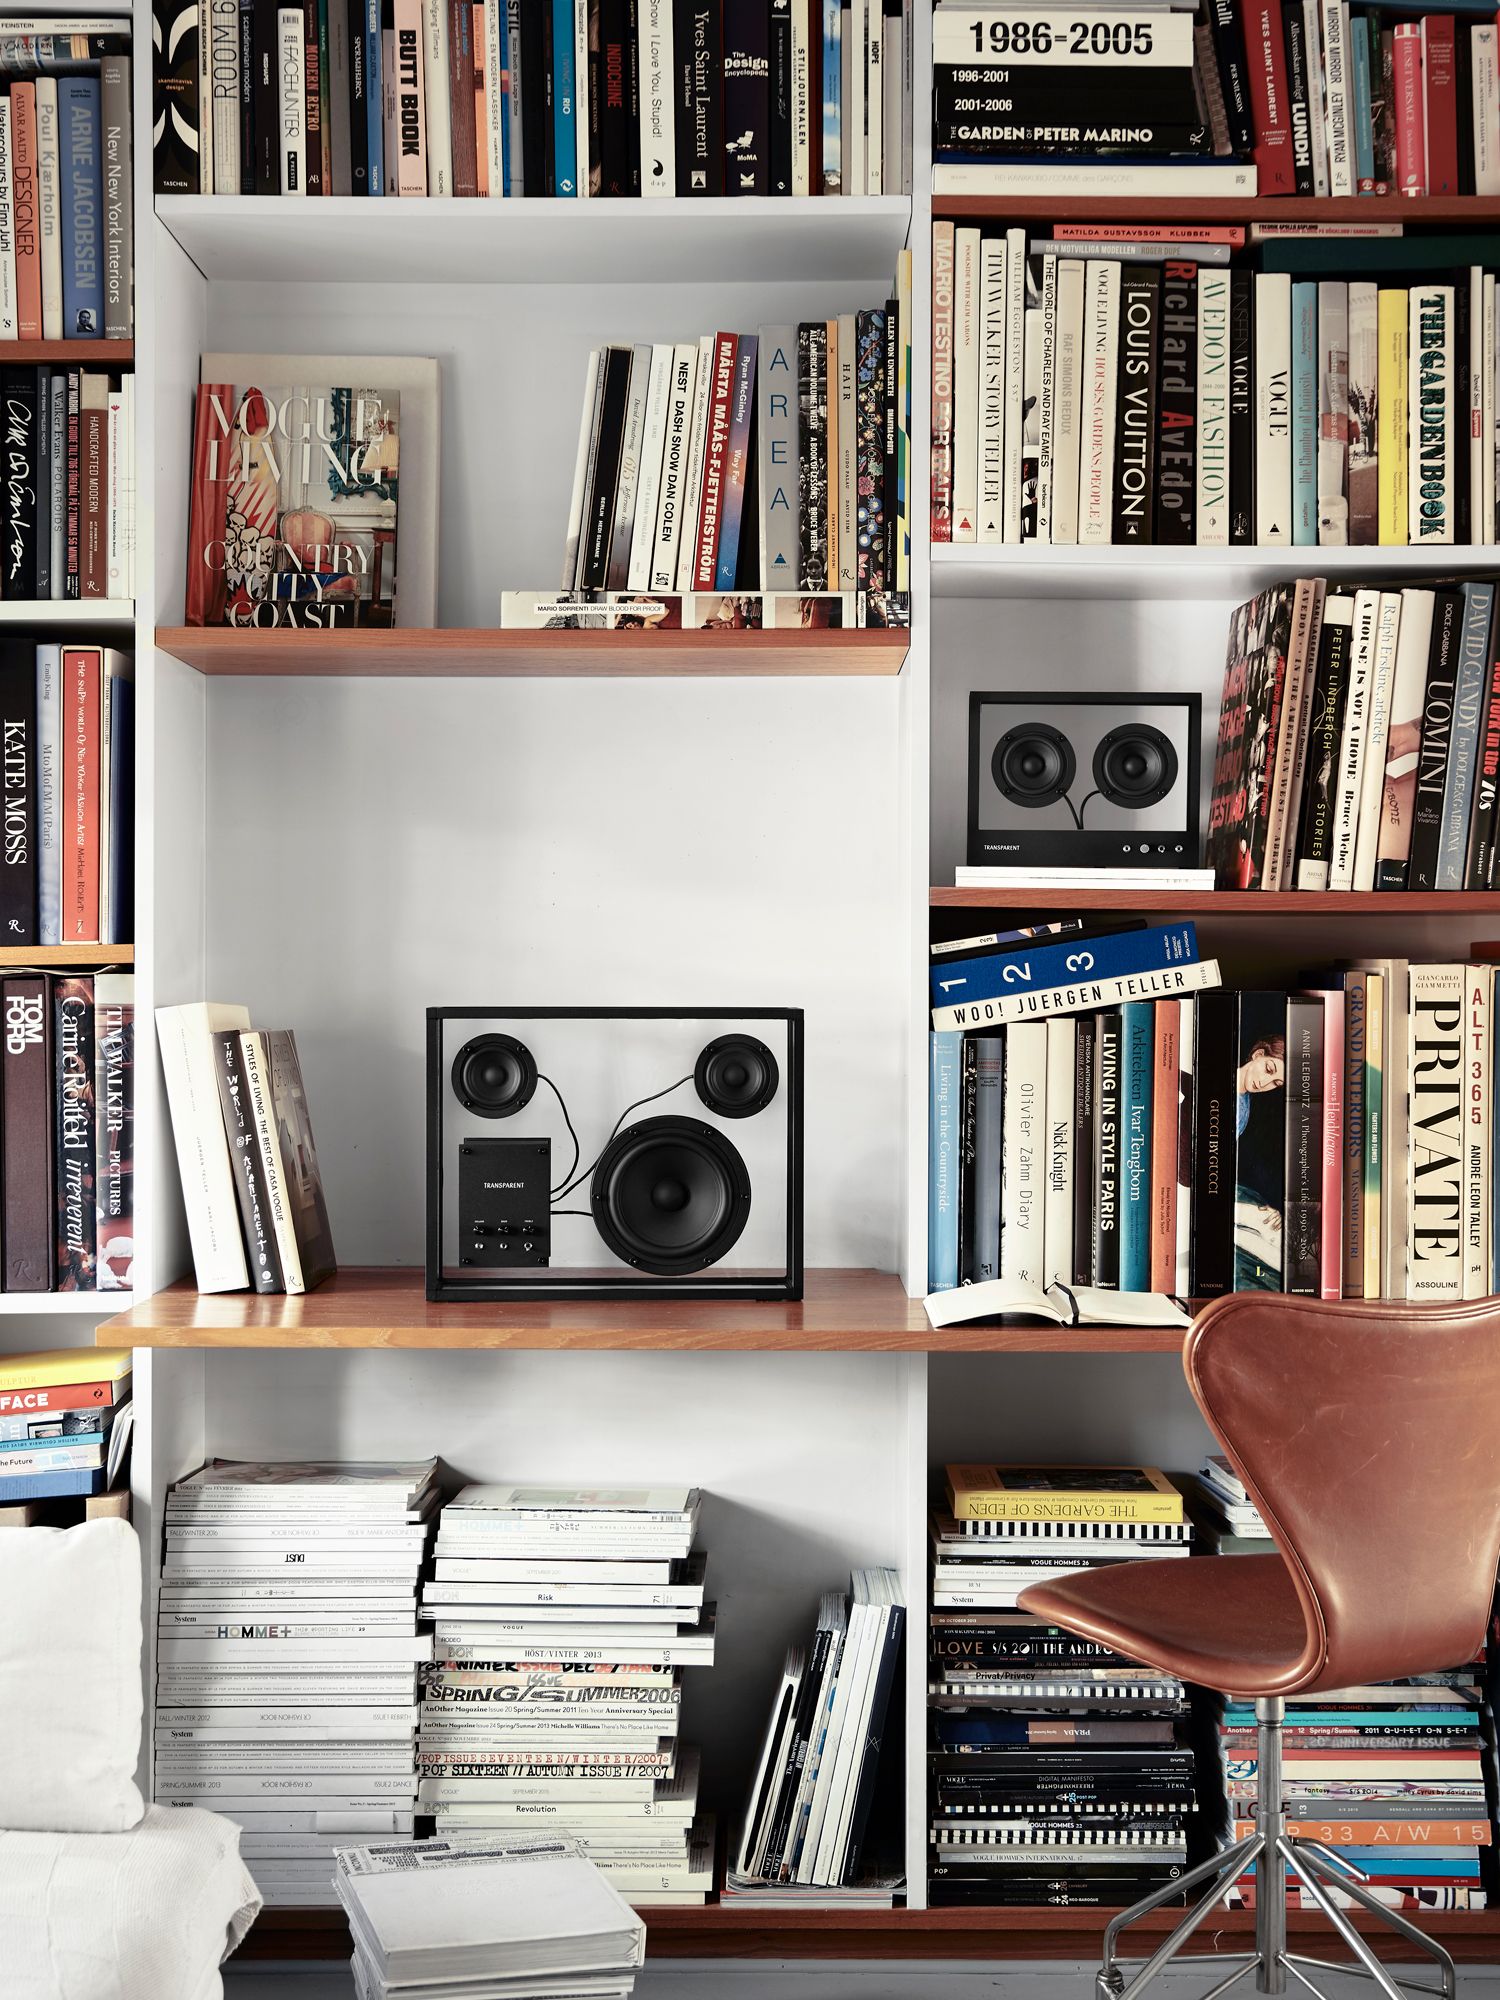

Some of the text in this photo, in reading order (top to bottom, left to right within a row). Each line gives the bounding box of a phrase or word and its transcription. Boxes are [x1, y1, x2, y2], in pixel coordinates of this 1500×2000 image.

[608, 44, 622, 108] INDOCHINE
[694, 10, 710, 158] Yves Saint Laurent
[724, 58, 768, 70] Design
[872, 40, 880, 64] HOPE
[952, 70, 1009, 82] 1996-2001
[284, 44, 299, 138] FACEHUNTER
[399, 30, 420, 156] BUTT BOOK
[798, 48, 806, 146] STILJOURNALEN
[954, 100, 1012, 111] 2001-2006
[70, 106, 94, 166] ARNE
[958, 126, 1153, 142] GARDEN PETER MARINO
[1292, 103, 1310, 167] LUNDH
[15, 92, 34, 256] ALVAR AALTO DESIGNER
[72, 169, 96, 289] JACOBSEN
[108, 126, 124, 304] New New York Interiors
[842, 364, 850, 400] HAIR
[1041, 261, 1054, 468] THE WORLD OF CHARLES AND RAY EAMES
[1203, 277, 1226, 508] AVEDON FASHION
[204, 394, 384, 442] VOGUE
[732, 356, 750, 486] Ryan McGinley Way Far
[1121, 292, 1151, 516] LOUIS VUITTON
[1269, 370, 1288, 437] VOGUE
[1420, 294, 1446, 536] THE GARDEN BOOK
[54, 390, 64, 532] Walker Evans POLAROIDS
[89, 416, 99, 512] HANDCRAFTED MODERN
[204, 440, 382, 486] LIVING
[662, 362, 688, 542] NEST DASH SNOW DAN COLEN
[699, 342, 734, 582] MÄRTA MÅÅS-FJETTERSTRÖM
[204, 541, 379, 574] COUNTRY
[247, 572, 336, 602] CITY
[230, 601, 345, 628] COAST
[1458, 594, 1490, 734] DAVID GANDY
[1312, 628, 1342, 857] PETER LINDBERGH STORIES
[1419, 680, 1454, 796] UOMINI
[4, 719, 27, 864] KATE MOSS
[940, 952, 1094, 992] 1 2 3
[954, 972, 1185, 1024] WOO! JUERGEN TELLER
[6, 994, 43, 1055] TOM FORD
[62, 996, 88, 1254] Carine Roitfeld irreverent
[1100, 1033, 1116, 1231] LIVING IN STYLE PARIS
[1126, 1024, 1146, 1201] Arkitekten Ivar Tengbom
[1414, 996, 1462, 1261] PRIVATE
[1017, 1084, 1034, 1230] Olivier Zahm Diary
[1049, 1122, 1068, 1192] Nick Knight
[1470, 1145, 1484, 1248] ANDRÉ LEON TALLEY
[968, 1502, 1138, 1518] THE GARDENS OF EDEN
[285, 1554, 305, 1563] DUST
[174, 1614, 196, 1624] System
[217, 1626, 292, 1638] HOMME+
[952, 1596, 974, 1604] System
[524, 1648, 671, 1662] HÖST/VINTER 2013 65
[938, 1642, 1064, 1655] LOVE THE
[976, 1672, 1036, 1681] Privat/Privacy
[422, 1764, 448, 1776] POP
[452, 1764, 510, 1776] SIXTEEN
[526, 1765, 576, 1777] AUTUMN
[580, 1766, 622, 1777] ISSUE
[638, 1766, 668, 1778] 2007
[516, 1803, 652, 1816] Revolution 69
[1320, 1826, 1484, 1842] 33 A/W 15
